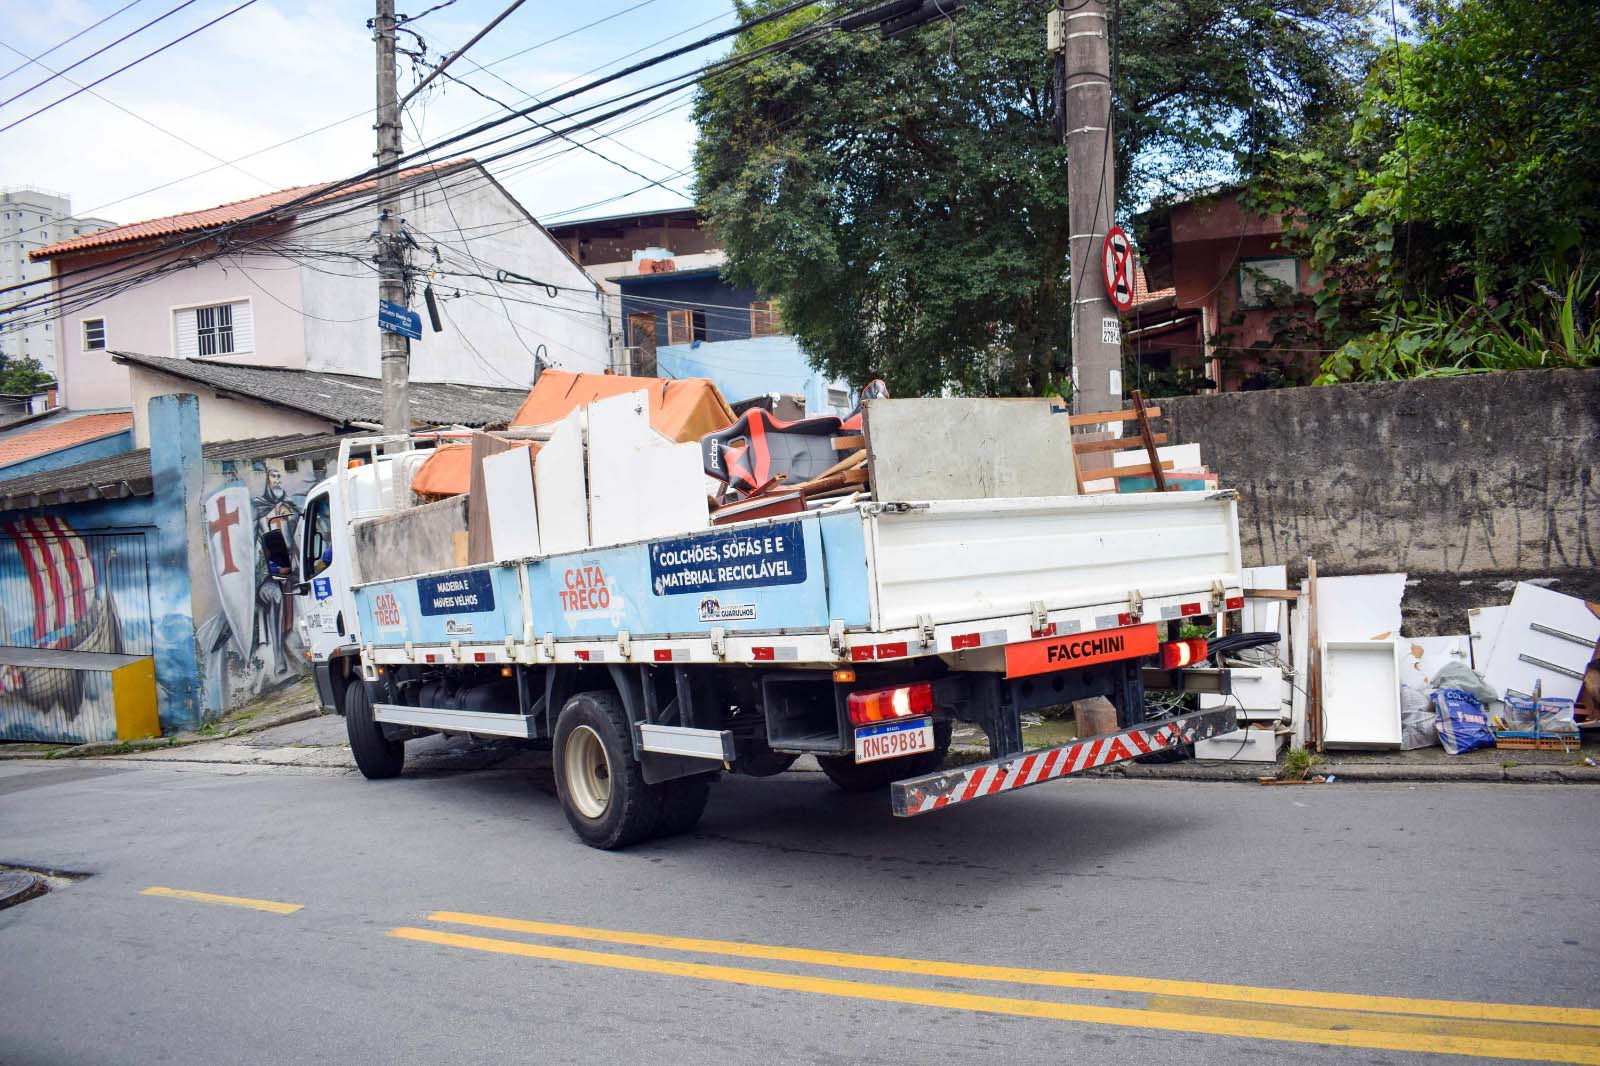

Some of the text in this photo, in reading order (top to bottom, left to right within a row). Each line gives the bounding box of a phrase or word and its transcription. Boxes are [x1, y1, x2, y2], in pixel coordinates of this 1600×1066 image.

[659, 537, 784, 567] COLCHÕES, SOFÁS E E
[564, 566, 606, 589] CATA
[661, 558, 792, 587] MATERIAL RECICLÁVEL
[437, 580, 469, 593] MADEIRA E
[376, 594, 397, 610] CATA
[455, 594, 478, 606] VELHOS
[560, 589, 610, 612] TRECO
[375, 609, 400, 626] TRECO
[721, 608, 753, 617] GUARULHOS
[1047, 636, 1125, 663] FACCHINI
[863, 730, 927, 758] RNG9B81
